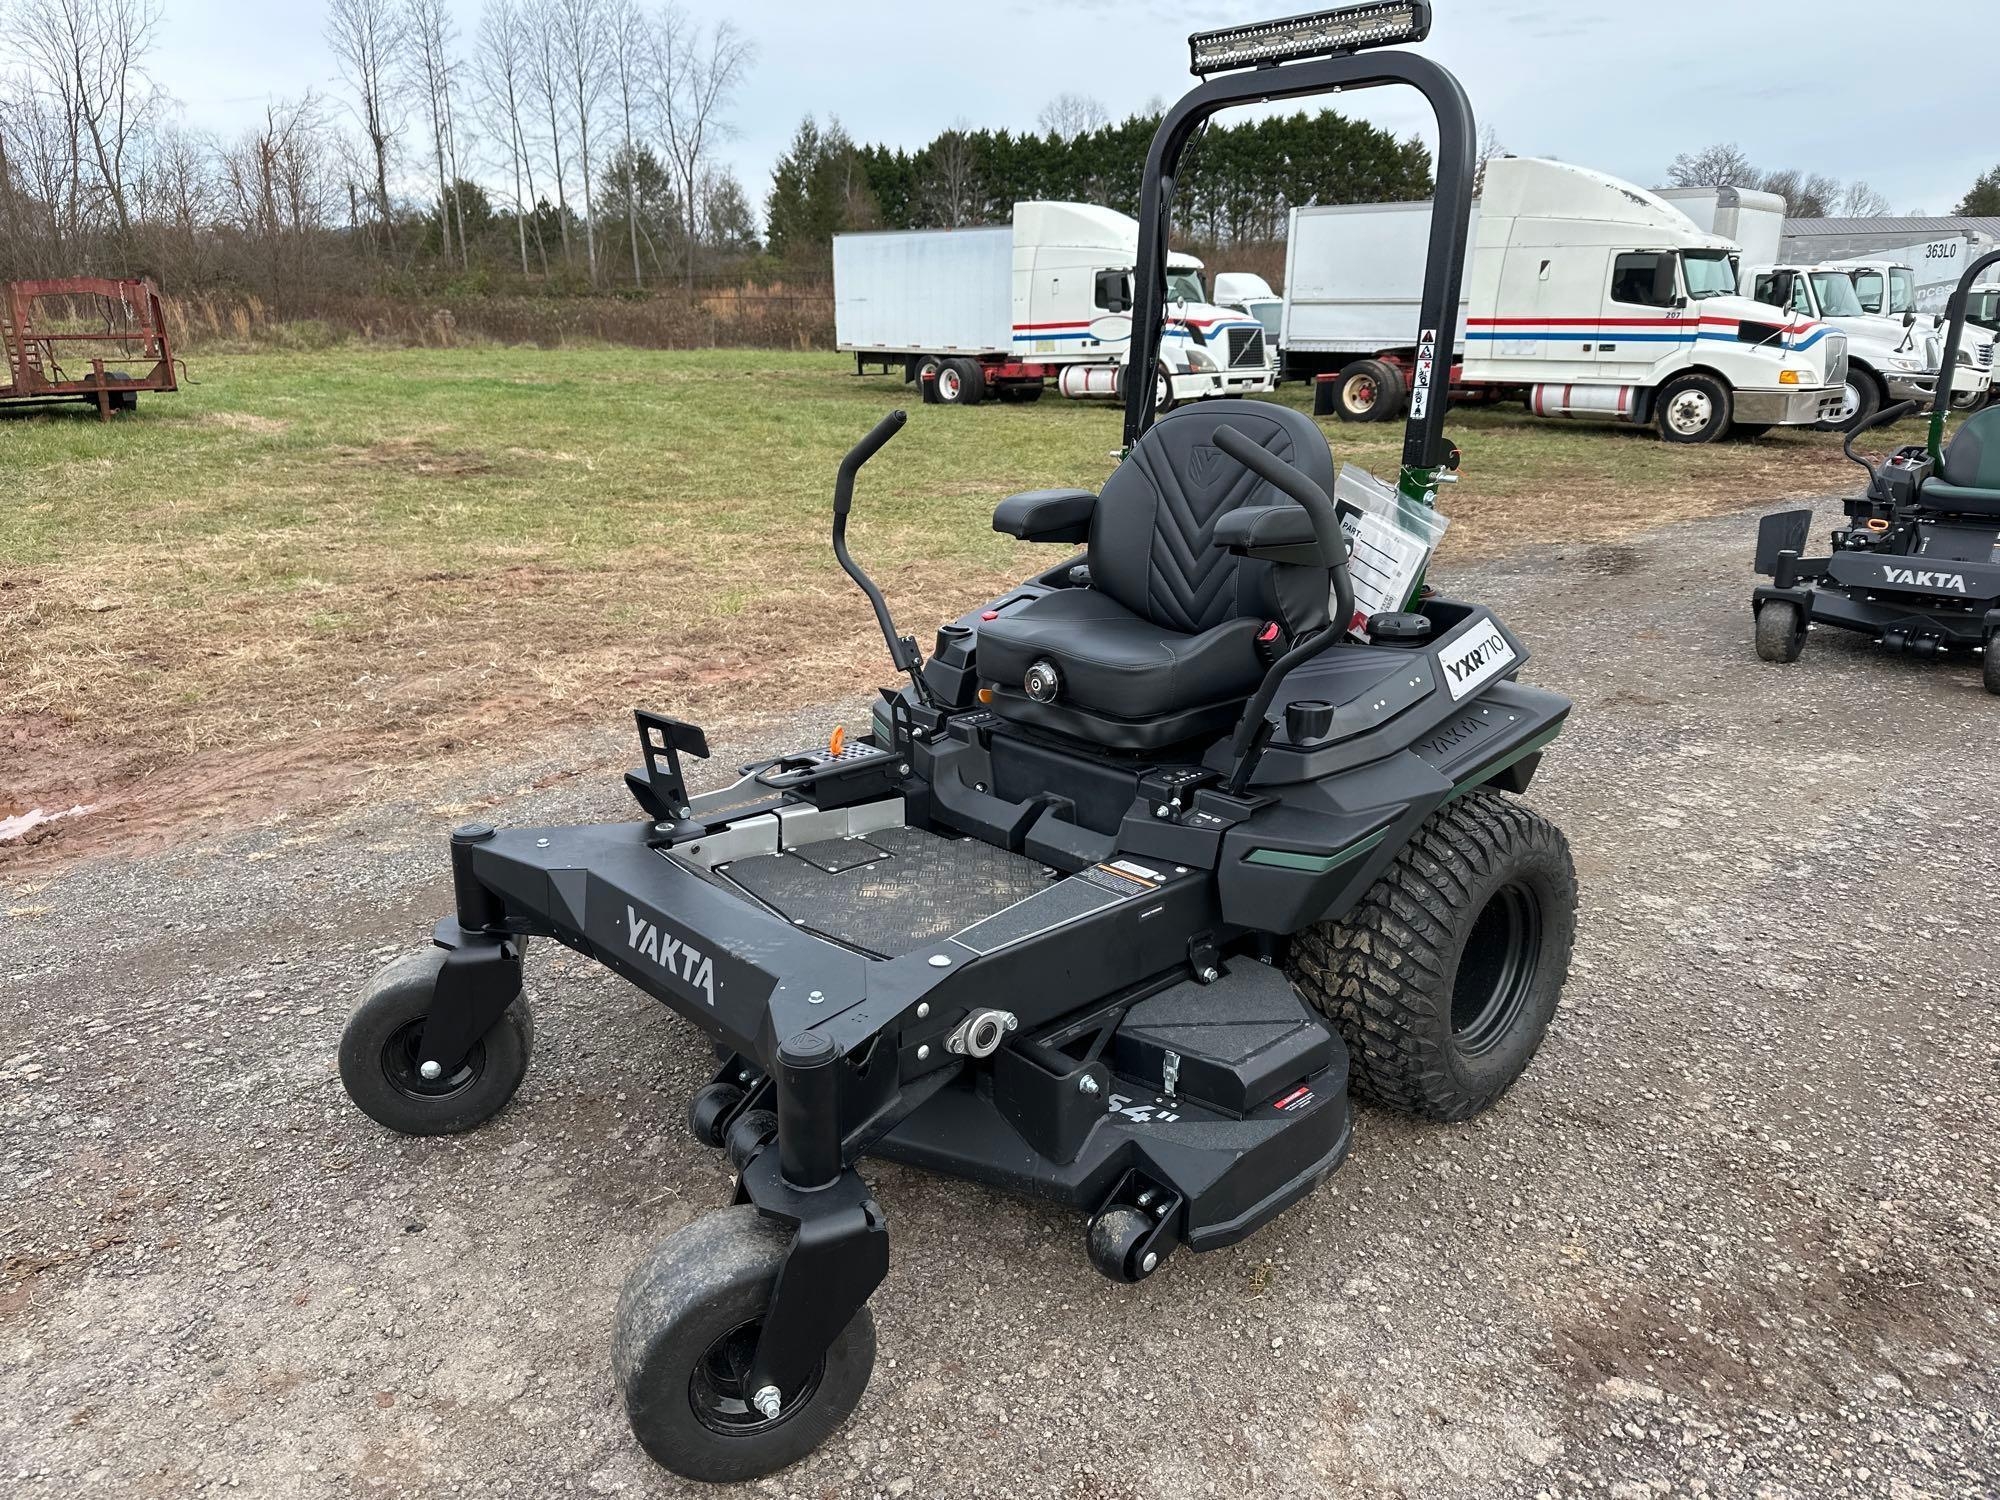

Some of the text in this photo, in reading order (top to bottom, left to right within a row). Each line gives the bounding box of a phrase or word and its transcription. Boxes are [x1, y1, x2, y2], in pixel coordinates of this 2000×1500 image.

[1342, 521, 1363, 539] PART:
[1883, 565, 1966, 593] YAKTA
[1446, 634, 1504, 682] YXR710
[1421, 716, 1490, 754] YAKTA
[627, 904, 715, 1007] YAKTA
